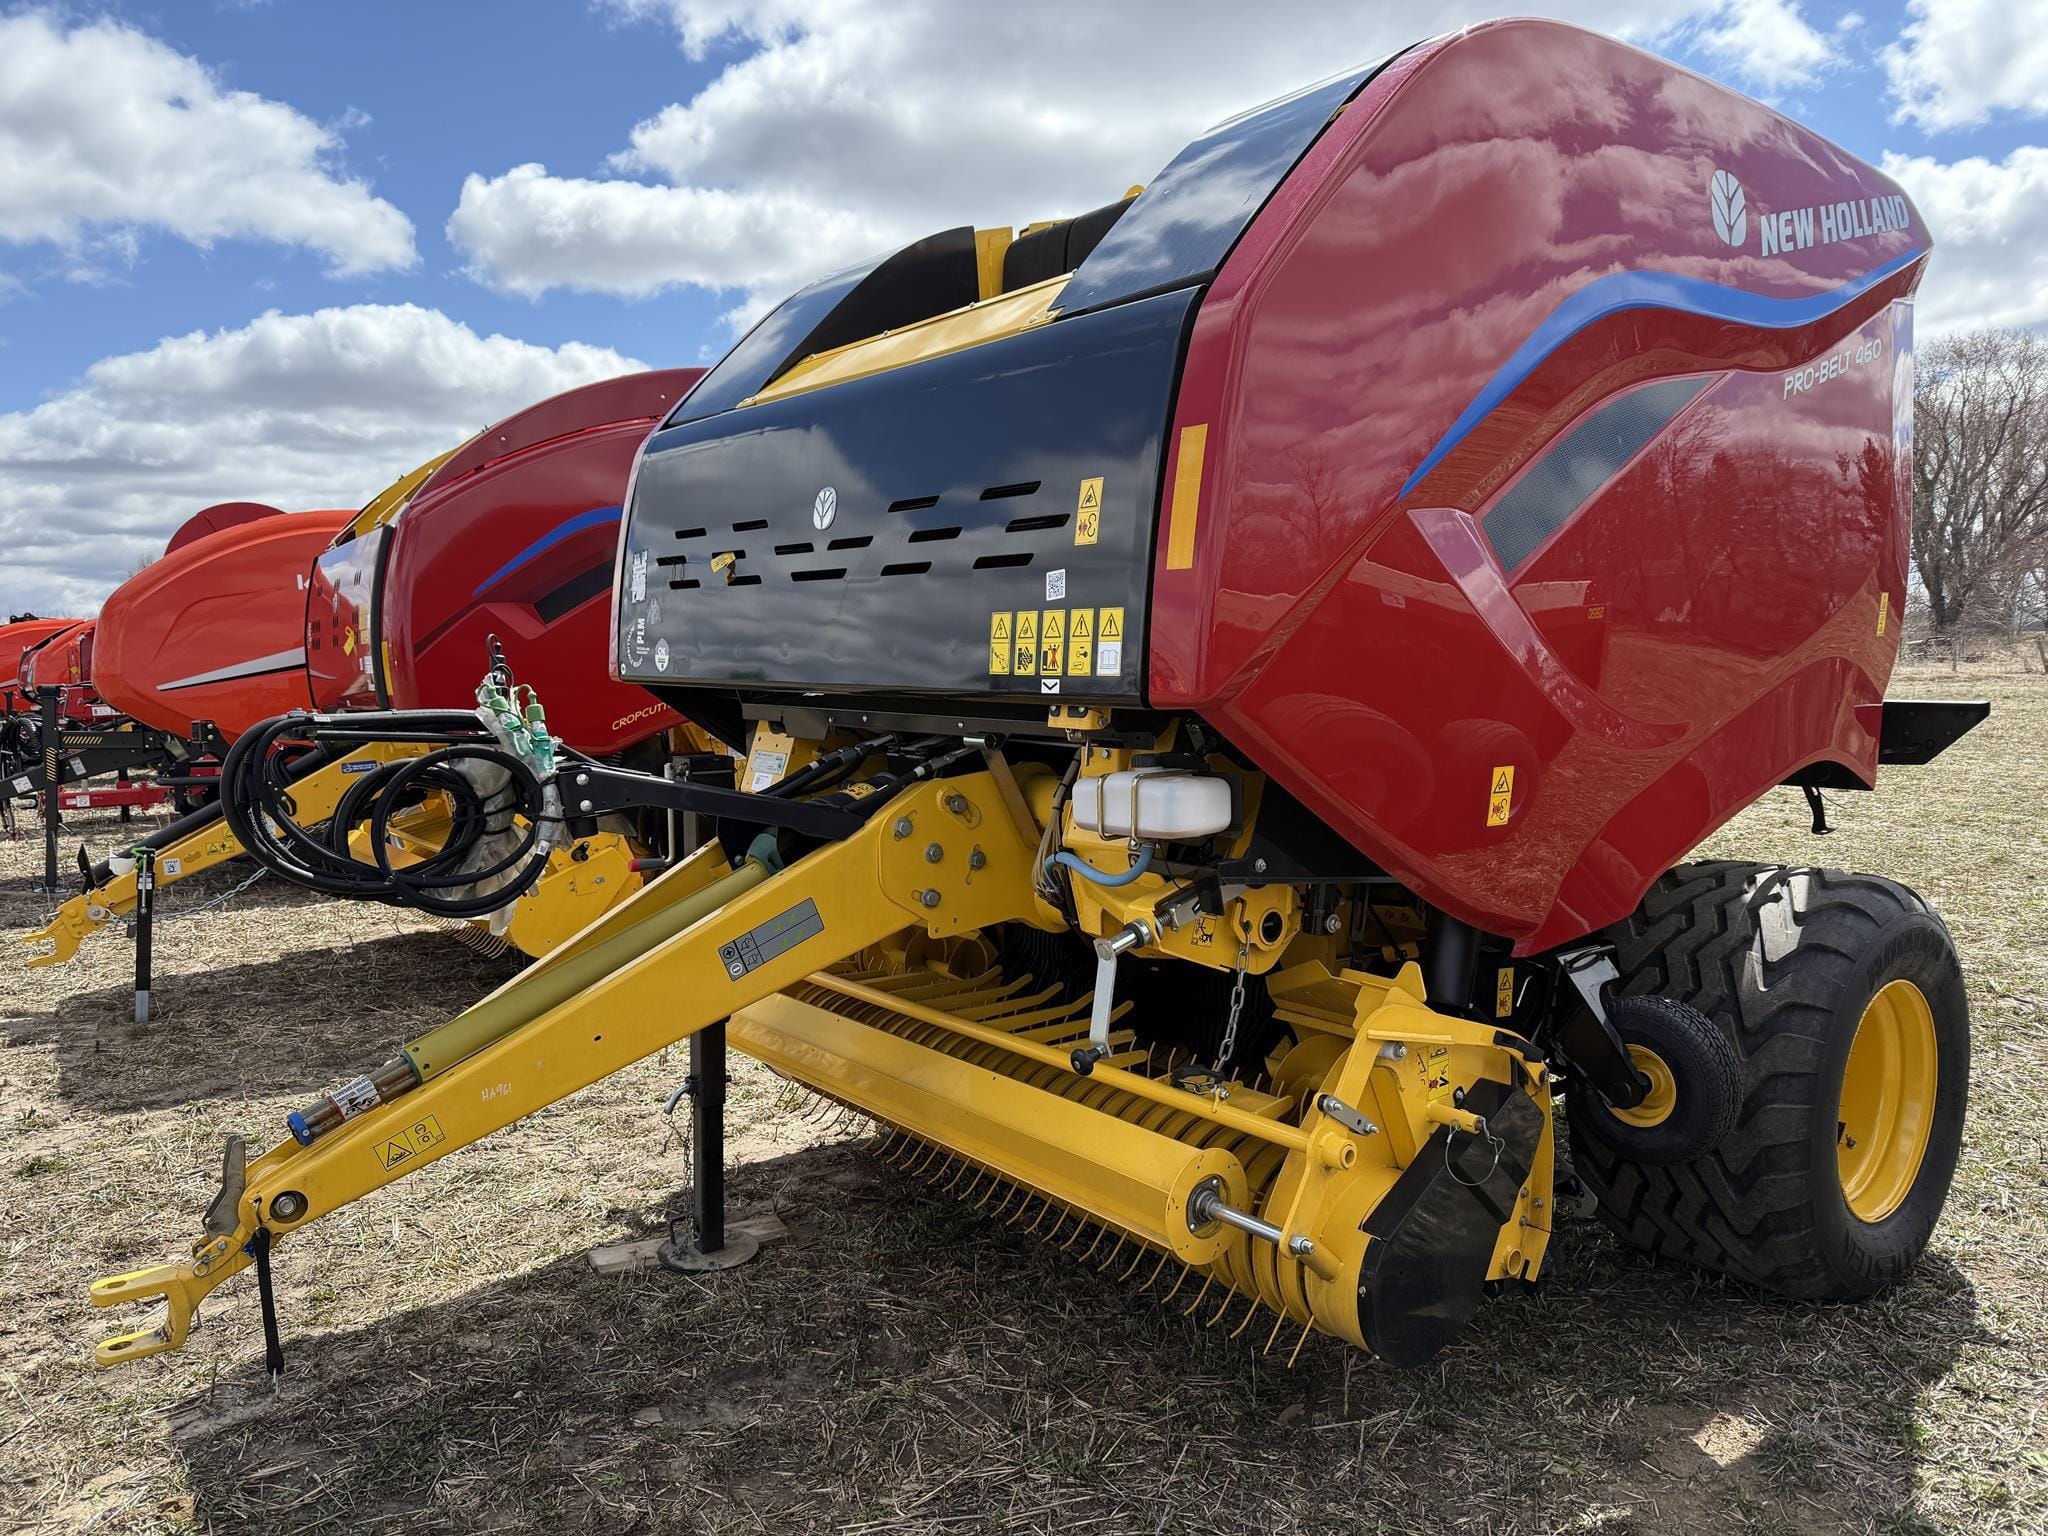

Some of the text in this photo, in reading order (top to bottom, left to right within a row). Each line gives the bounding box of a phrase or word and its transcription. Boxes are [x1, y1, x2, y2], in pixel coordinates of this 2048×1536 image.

[1761, 195, 1910, 257] NEW HOLLAND
[1783, 339, 1882, 400] PRO-BELT 460
[637, 618, 645, 644] PLM
[612, 702, 670, 730] CROPCUTT
